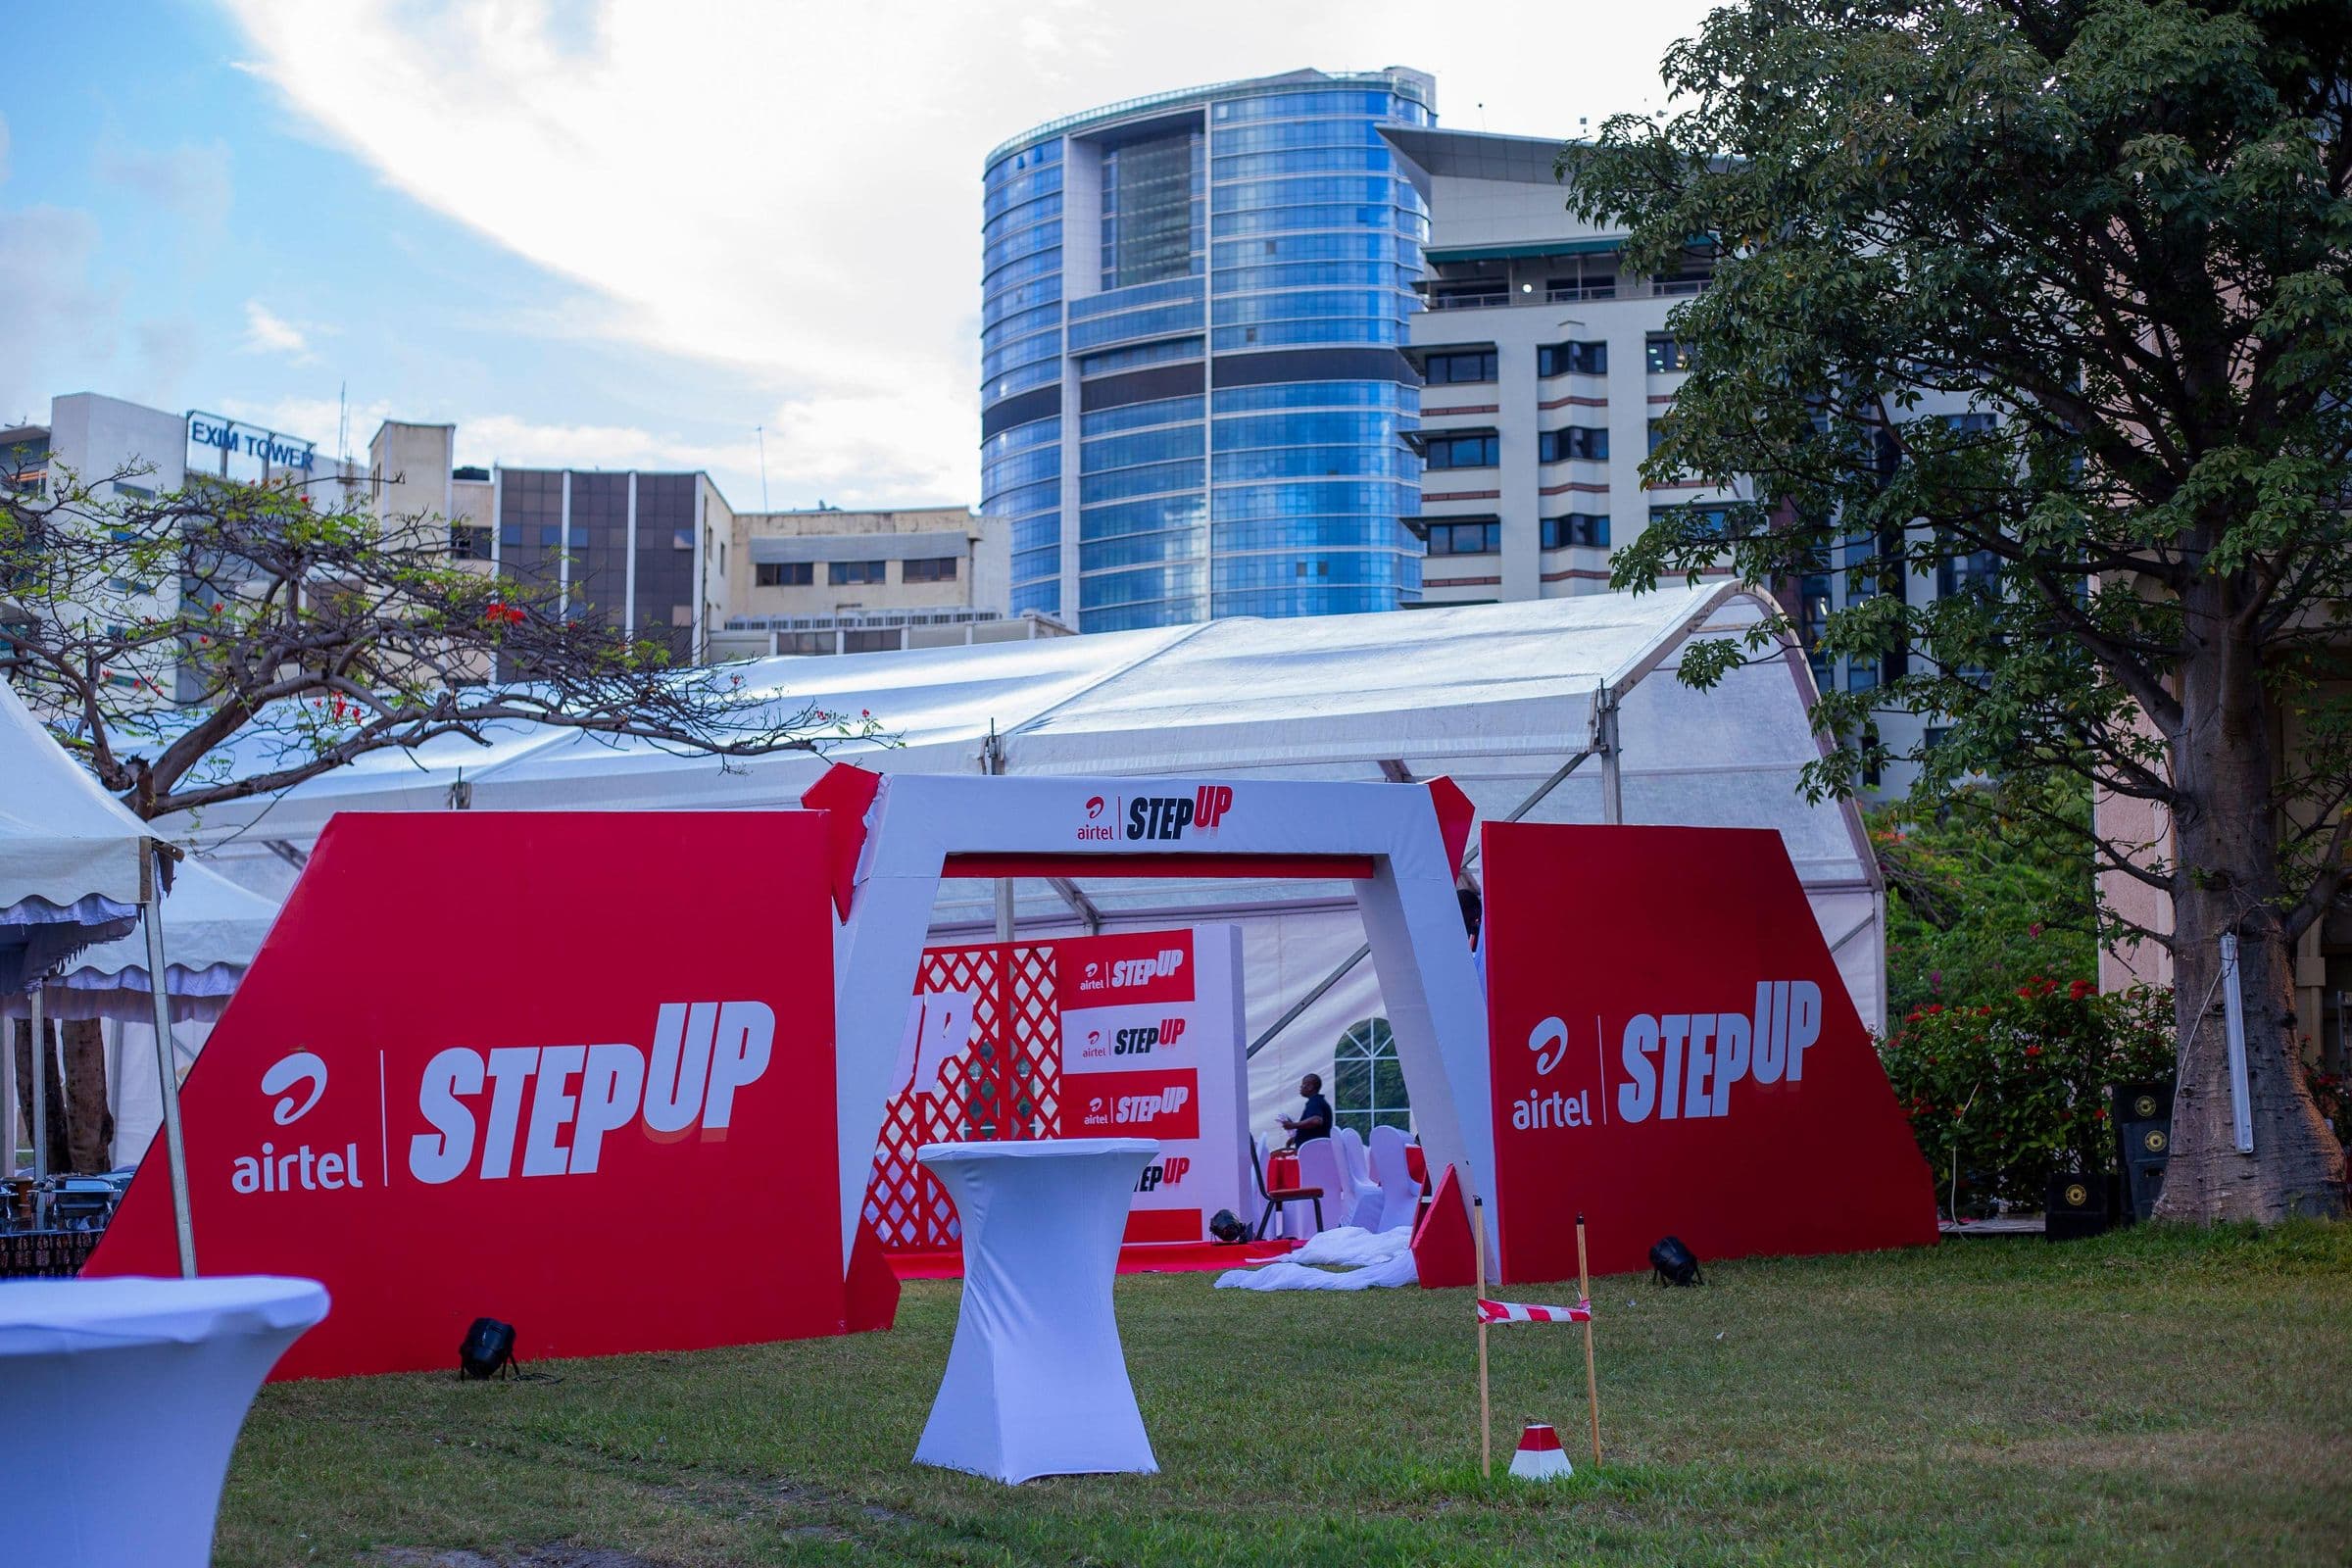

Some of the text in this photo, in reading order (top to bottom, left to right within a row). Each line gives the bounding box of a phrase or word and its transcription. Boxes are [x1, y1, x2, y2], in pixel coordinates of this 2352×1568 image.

[192, 420, 314, 472] EXIM TOWER
[1077, 824, 1114, 840] airtel
[1080, 979, 1104, 991] airtel
[1082, 1047, 1106, 1058] airtel
[1512, 1088, 1592, 1130] airtel
[1084, 1113, 1108, 1125] airtel
[231, 1142, 364, 1194] airtel
